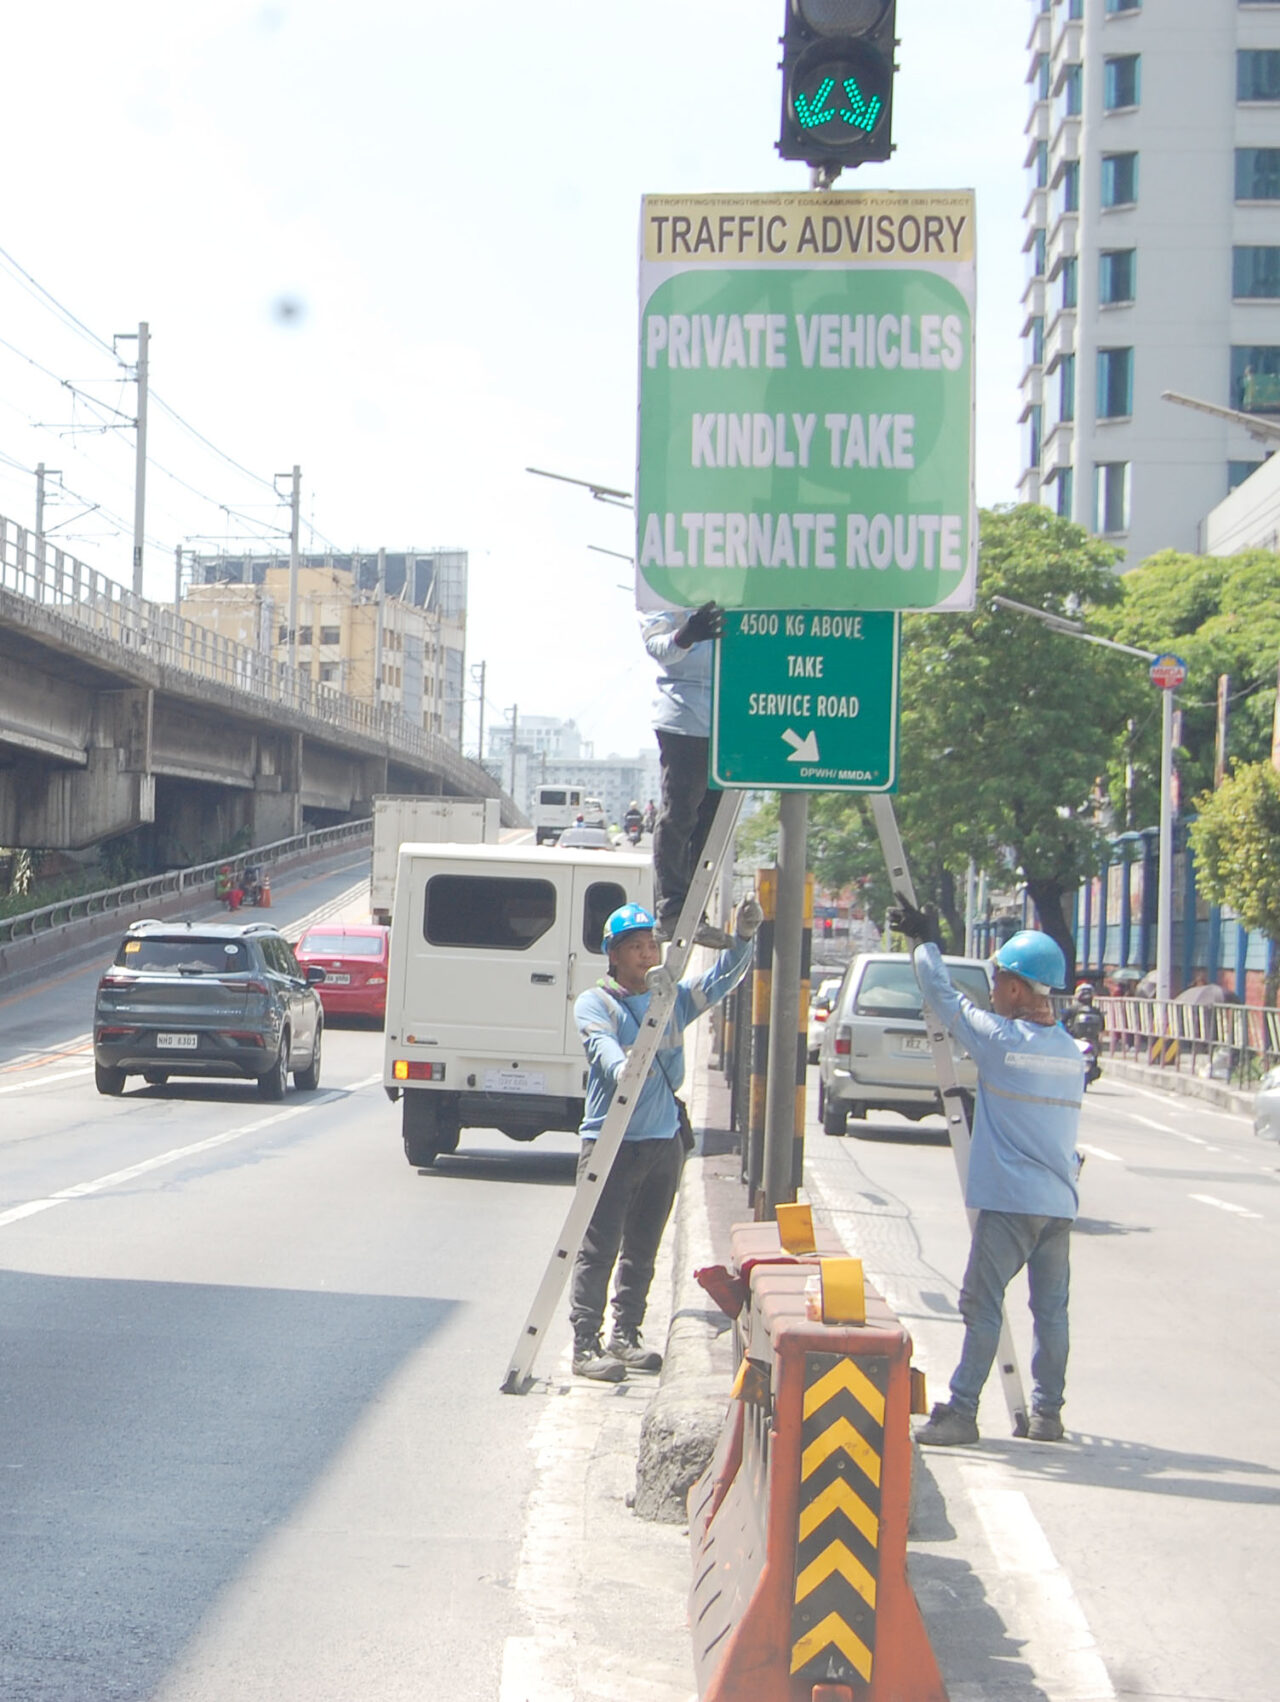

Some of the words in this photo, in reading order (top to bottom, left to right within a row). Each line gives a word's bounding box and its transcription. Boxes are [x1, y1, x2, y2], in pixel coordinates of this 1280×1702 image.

[651, 216, 788, 254] TRAFFIC
[797, 214, 968, 254] ADVISORY
[646, 313, 788, 369] PRIVATE
[795, 313, 964, 371] VEHICLES
[691, 413, 817, 469] KINDLY
[825, 413, 915, 469] TAKE
[640, 512, 837, 569] ALTERNATE
[846, 513, 963, 571] ROUTE
[740, 614, 779, 635] 4500
[786, 615, 805, 636] KG
[810, 616, 862, 638] ABOVE
[787, 656, 824, 678] TAKE
[748, 693, 811, 716] SERVICE
[817, 696, 860, 718] ROAD
[838, 769, 872, 781] MMDA
